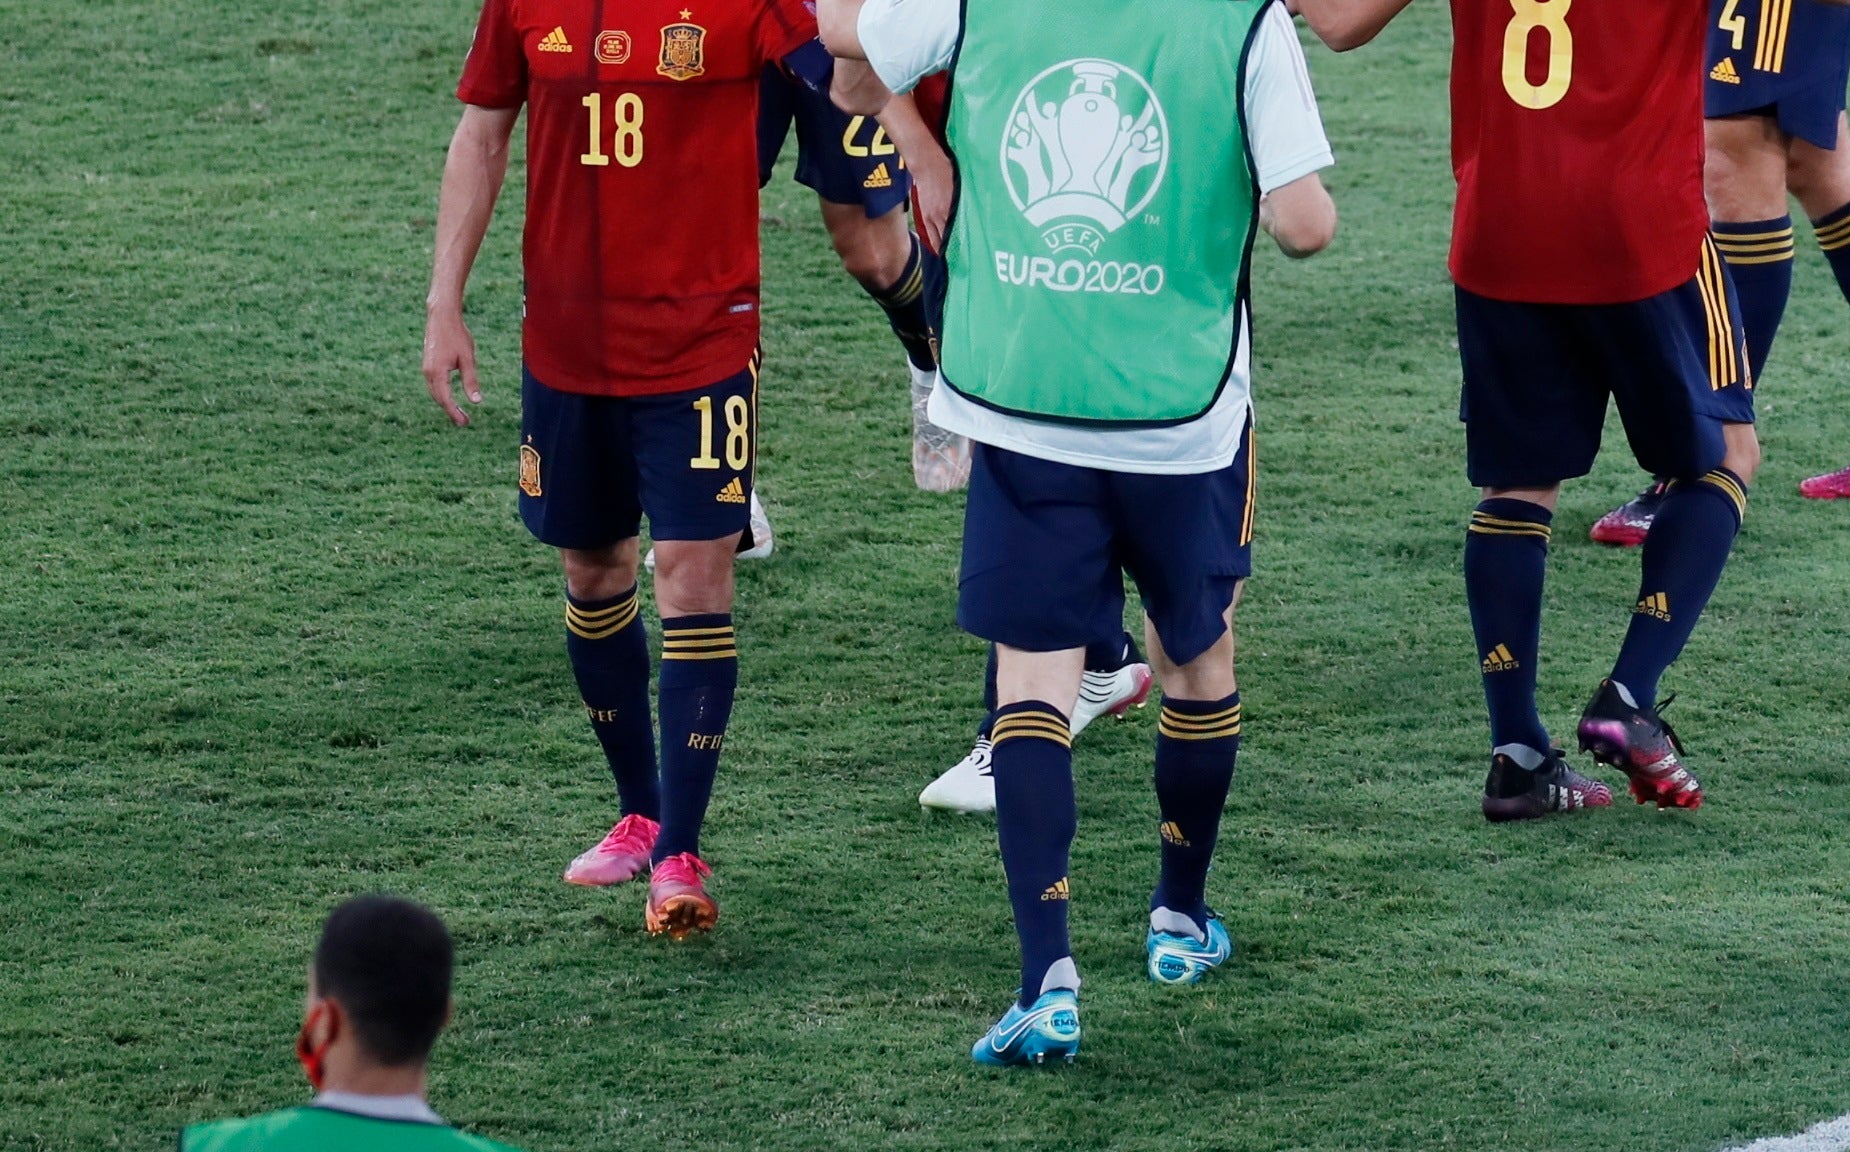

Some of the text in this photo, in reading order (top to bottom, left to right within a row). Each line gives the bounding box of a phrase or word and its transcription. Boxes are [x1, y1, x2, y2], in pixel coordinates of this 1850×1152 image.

[537, 41, 573, 53] adidas
[580, 92, 644, 168] 18
[1044, 228, 1101, 253] UEFA
[995, 250, 1164, 295] EURO2020
[690, 395, 749, 471] 18
[716, 492, 745, 504] adidas
